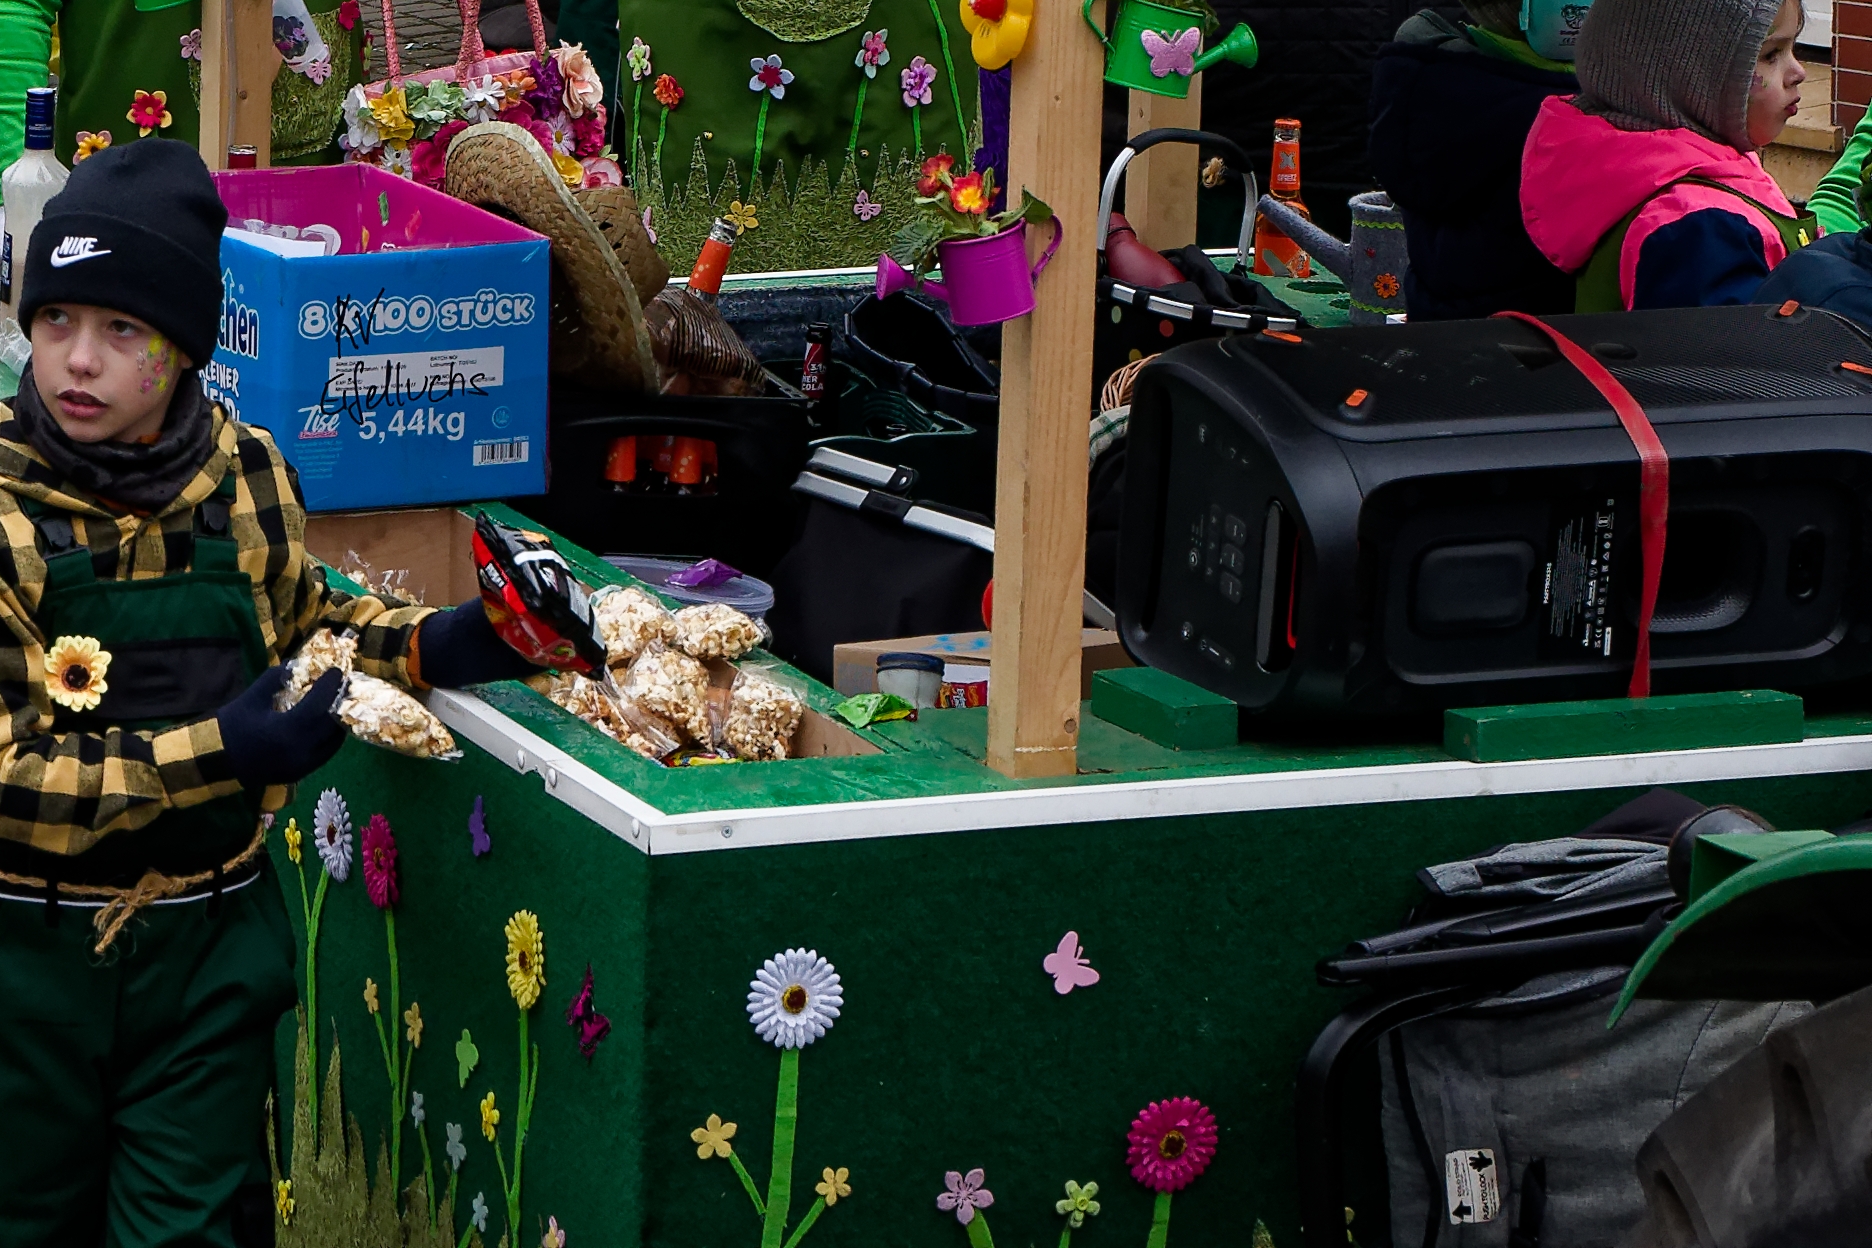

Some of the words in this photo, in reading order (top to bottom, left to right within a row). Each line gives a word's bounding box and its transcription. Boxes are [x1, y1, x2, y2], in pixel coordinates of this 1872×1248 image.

[59, 236, 98, 255] NIKE
[303, 304, 326, 334] 8
[371, 297, 430, 332] 100
[440, 292, 531, 327] STÜCK
[359, 407, 465, 444] 5,44kg
